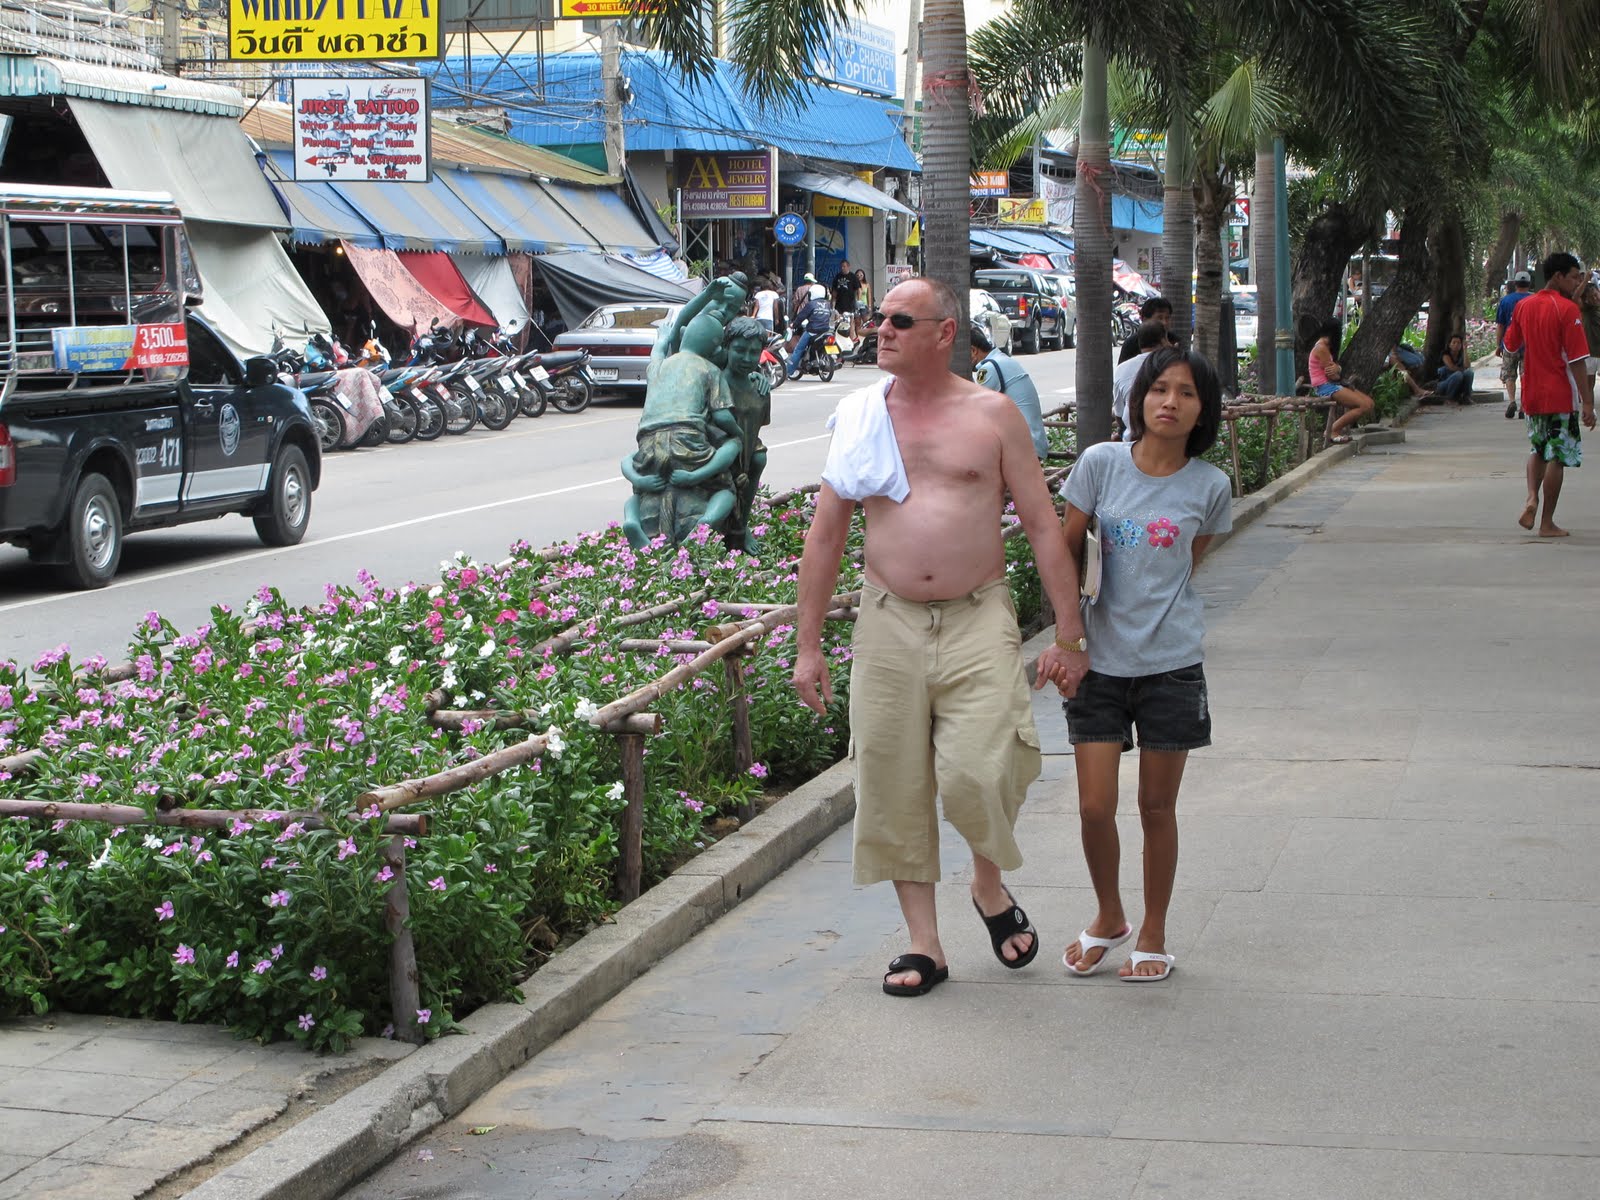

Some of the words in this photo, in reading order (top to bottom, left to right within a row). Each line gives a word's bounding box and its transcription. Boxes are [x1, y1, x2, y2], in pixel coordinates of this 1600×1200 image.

[859, 47, 894, 72] CHAROEN
[845, 61, 889, 88] OPTICAL
[298, 99, 347, 115] JIRST
[354, 99, 420, 115] TATTOO
[316, 156, 345, 164] inside
[729, 160, 764, 169] HOTEL
[684, 157, 727, 188] AA
[728, 174, 766, 184] JEWELRY
[729, 194, 766, 207] RESTAURANT
[140, 327, 175, 349] 3,500
[160, 438, 180, 467] 471
